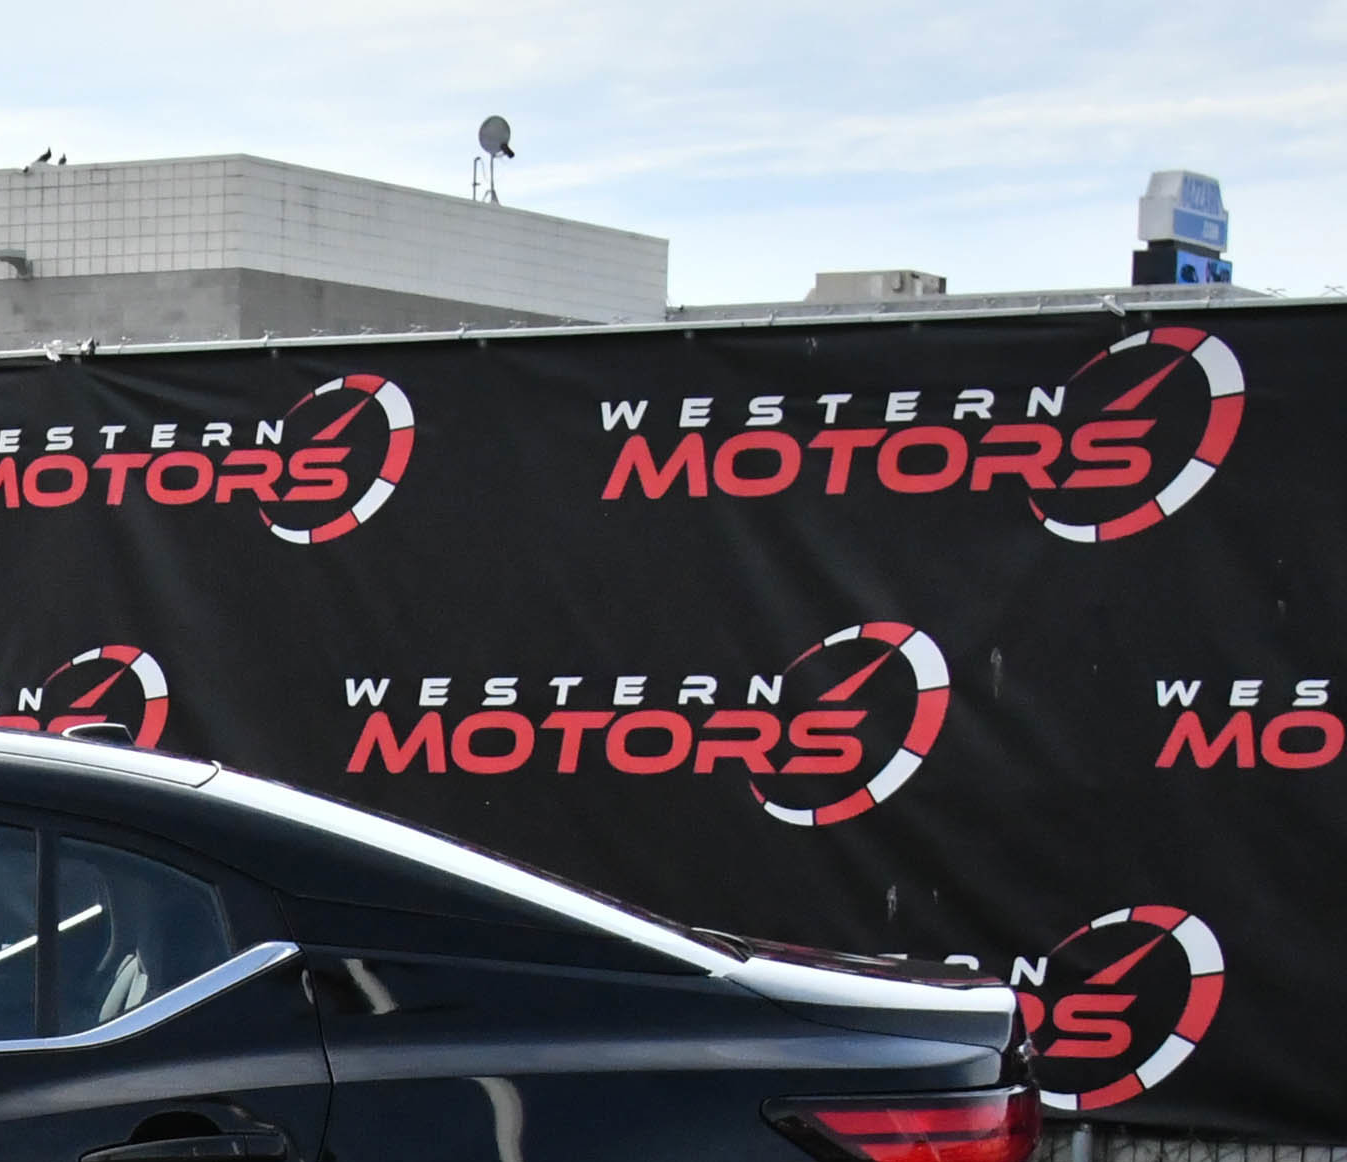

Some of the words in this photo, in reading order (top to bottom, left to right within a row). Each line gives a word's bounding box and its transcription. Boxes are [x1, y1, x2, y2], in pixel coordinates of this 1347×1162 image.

[600, 385, 1066, 432] WESTERN
[602, 418, 1157, 501] MOTORS
[345, 674, 783, 707] WESTERN
[346, 708, 868, 776] MOTORS
